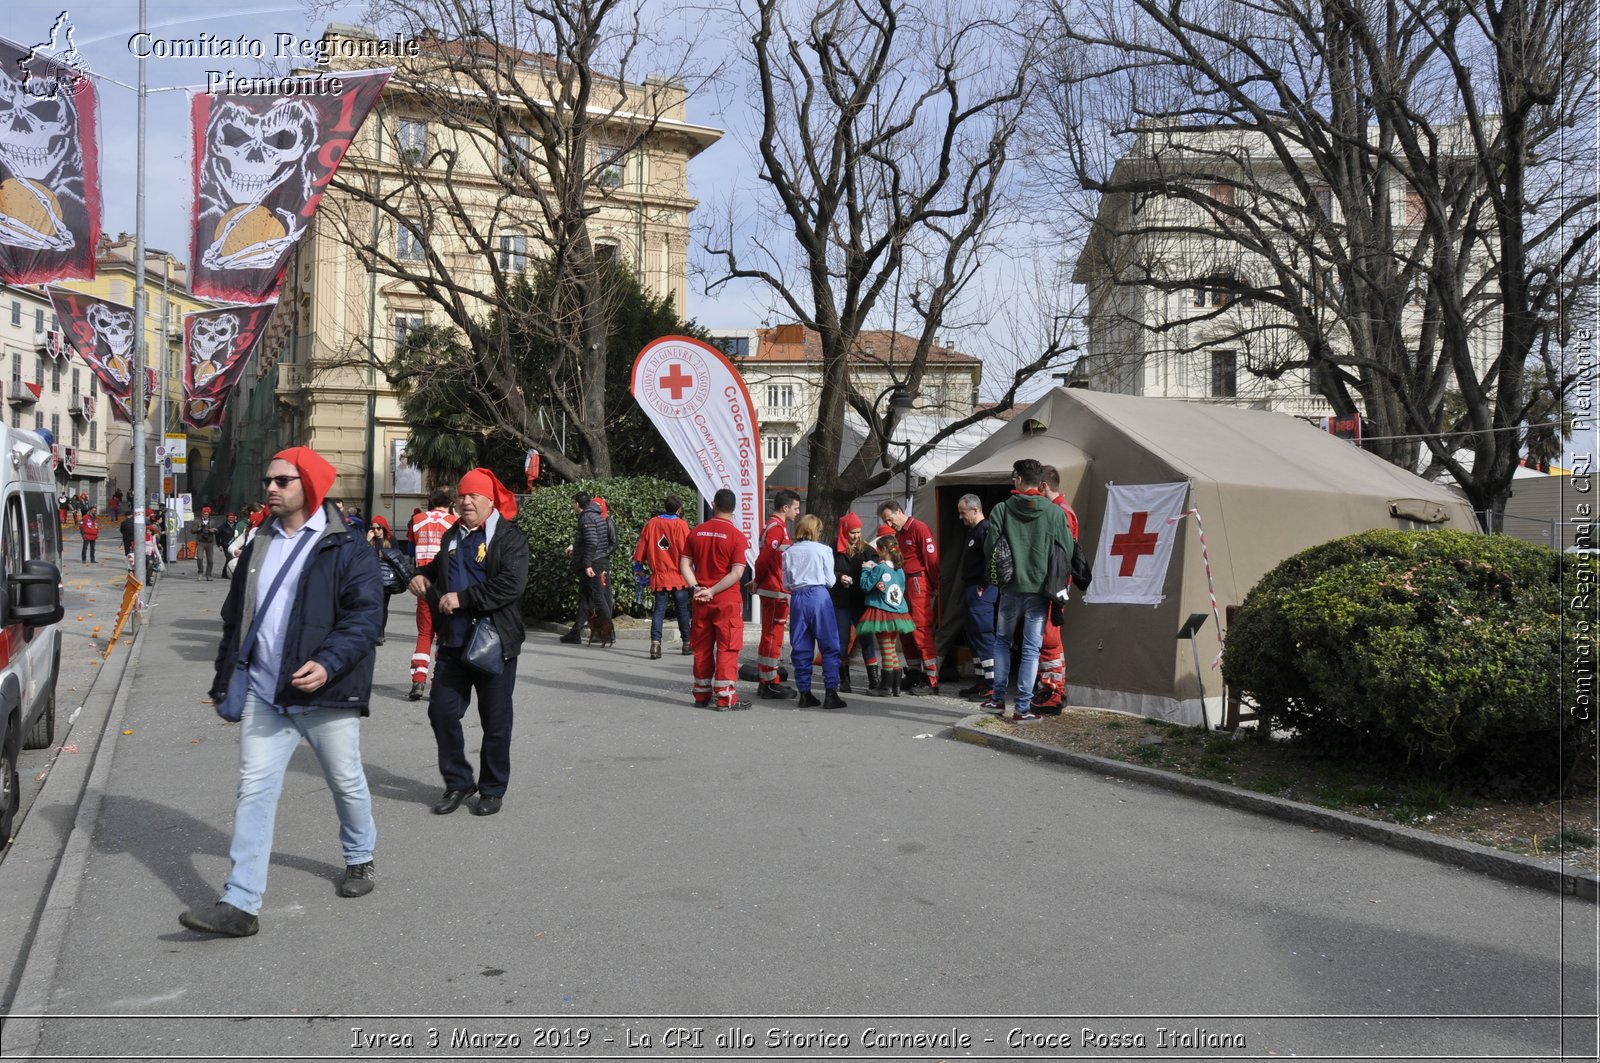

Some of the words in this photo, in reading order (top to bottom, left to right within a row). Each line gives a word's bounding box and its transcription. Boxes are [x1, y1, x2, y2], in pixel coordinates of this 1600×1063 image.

[650, 355, 660, 368] DI
[658, 348, 693, 362] GINEVRA
[644, 368, 674, 416] CONVENZIONE
[695, 371, 709, 403] AGOSTO
[724, 385, 745, 432] Croce
[738, 437, 751, 487] Rossa
[696, 448, 713, 479] IVREA
